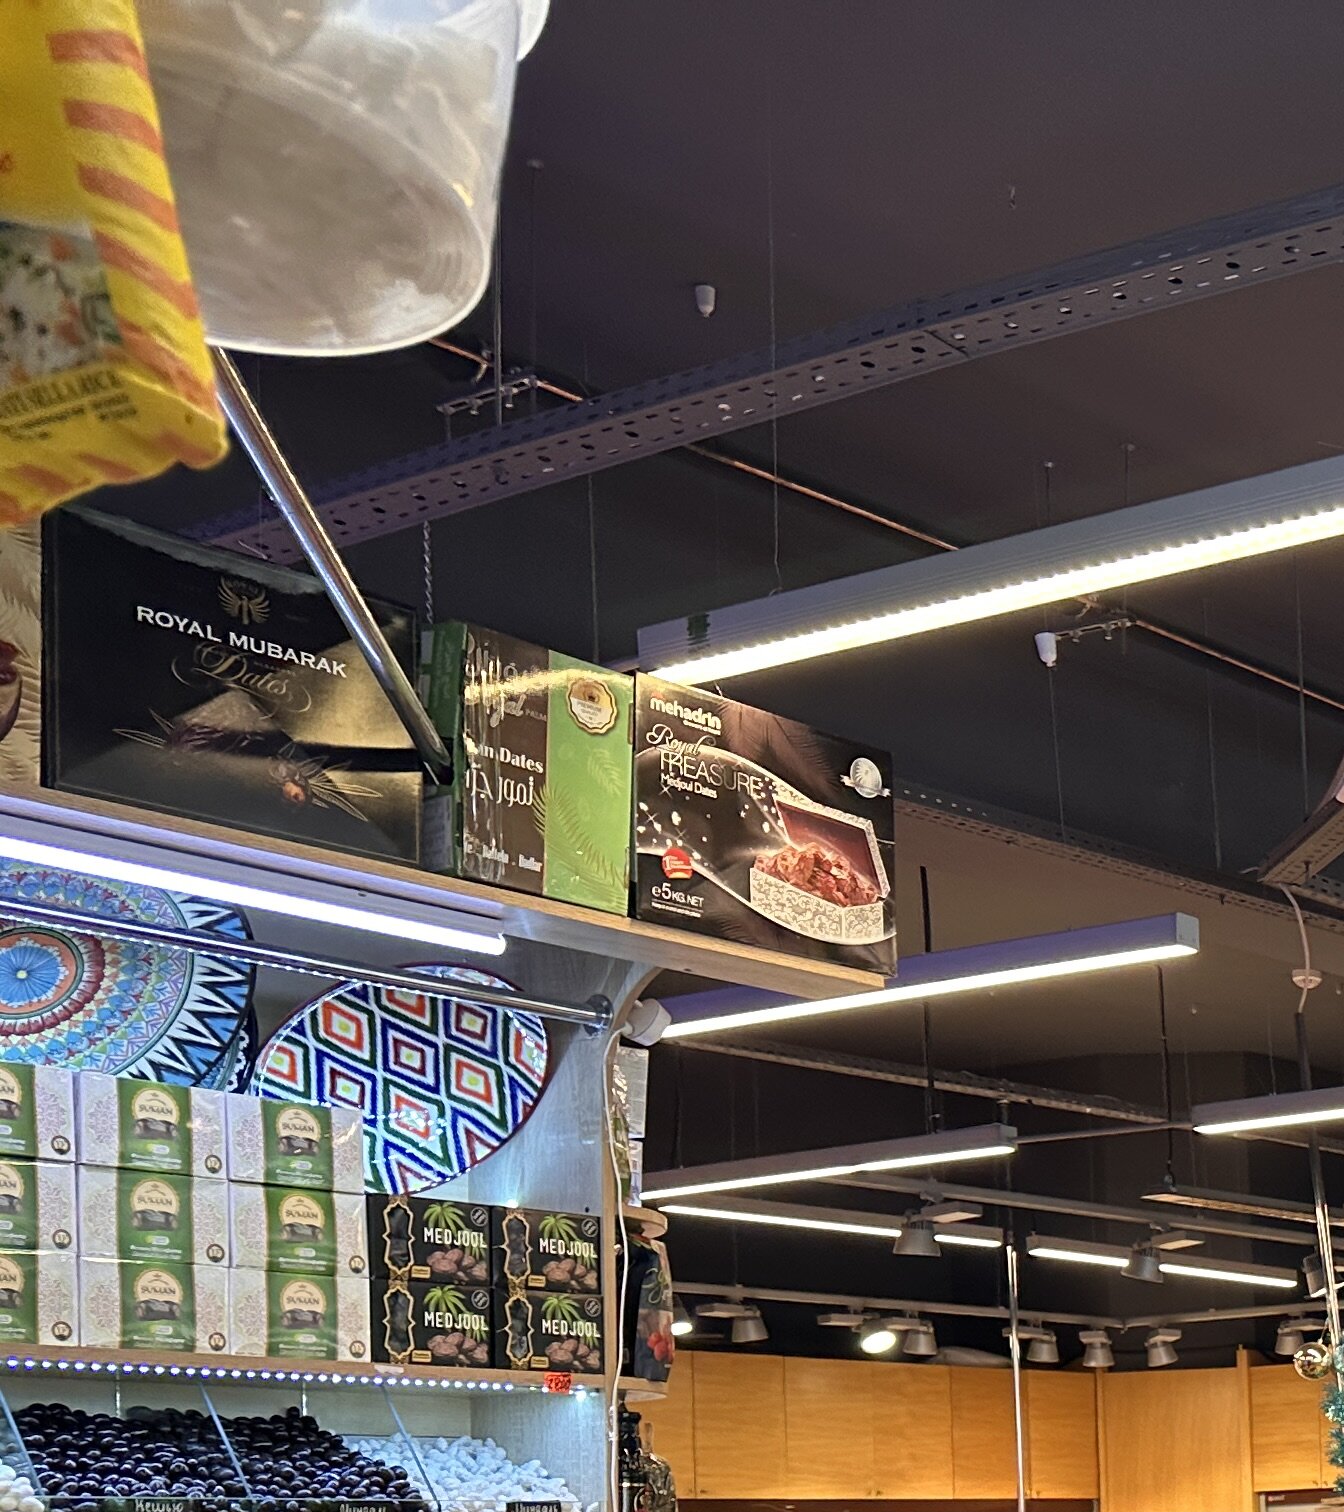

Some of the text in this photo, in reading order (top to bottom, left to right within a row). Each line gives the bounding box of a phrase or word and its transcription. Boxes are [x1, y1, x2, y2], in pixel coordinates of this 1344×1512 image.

[137, 605, 348, 679] ROYAL MUBARAK
[194, 643, 290, 697] Dates
[650, 696, 721, 730] mehadrin
[646, 723, 717, 757] Royal
[499, 746, 544, 774] Dates
[660, 751, 763, 800] TREASURE
[423, 1226, 488, 1249] MEDJOOL
[539, 1237, 598, 1259] MEDJOOL
[424, 1311, 490, 1331] MEDJOOL
[541, 1318, 601, 1338] MEDJOOL
